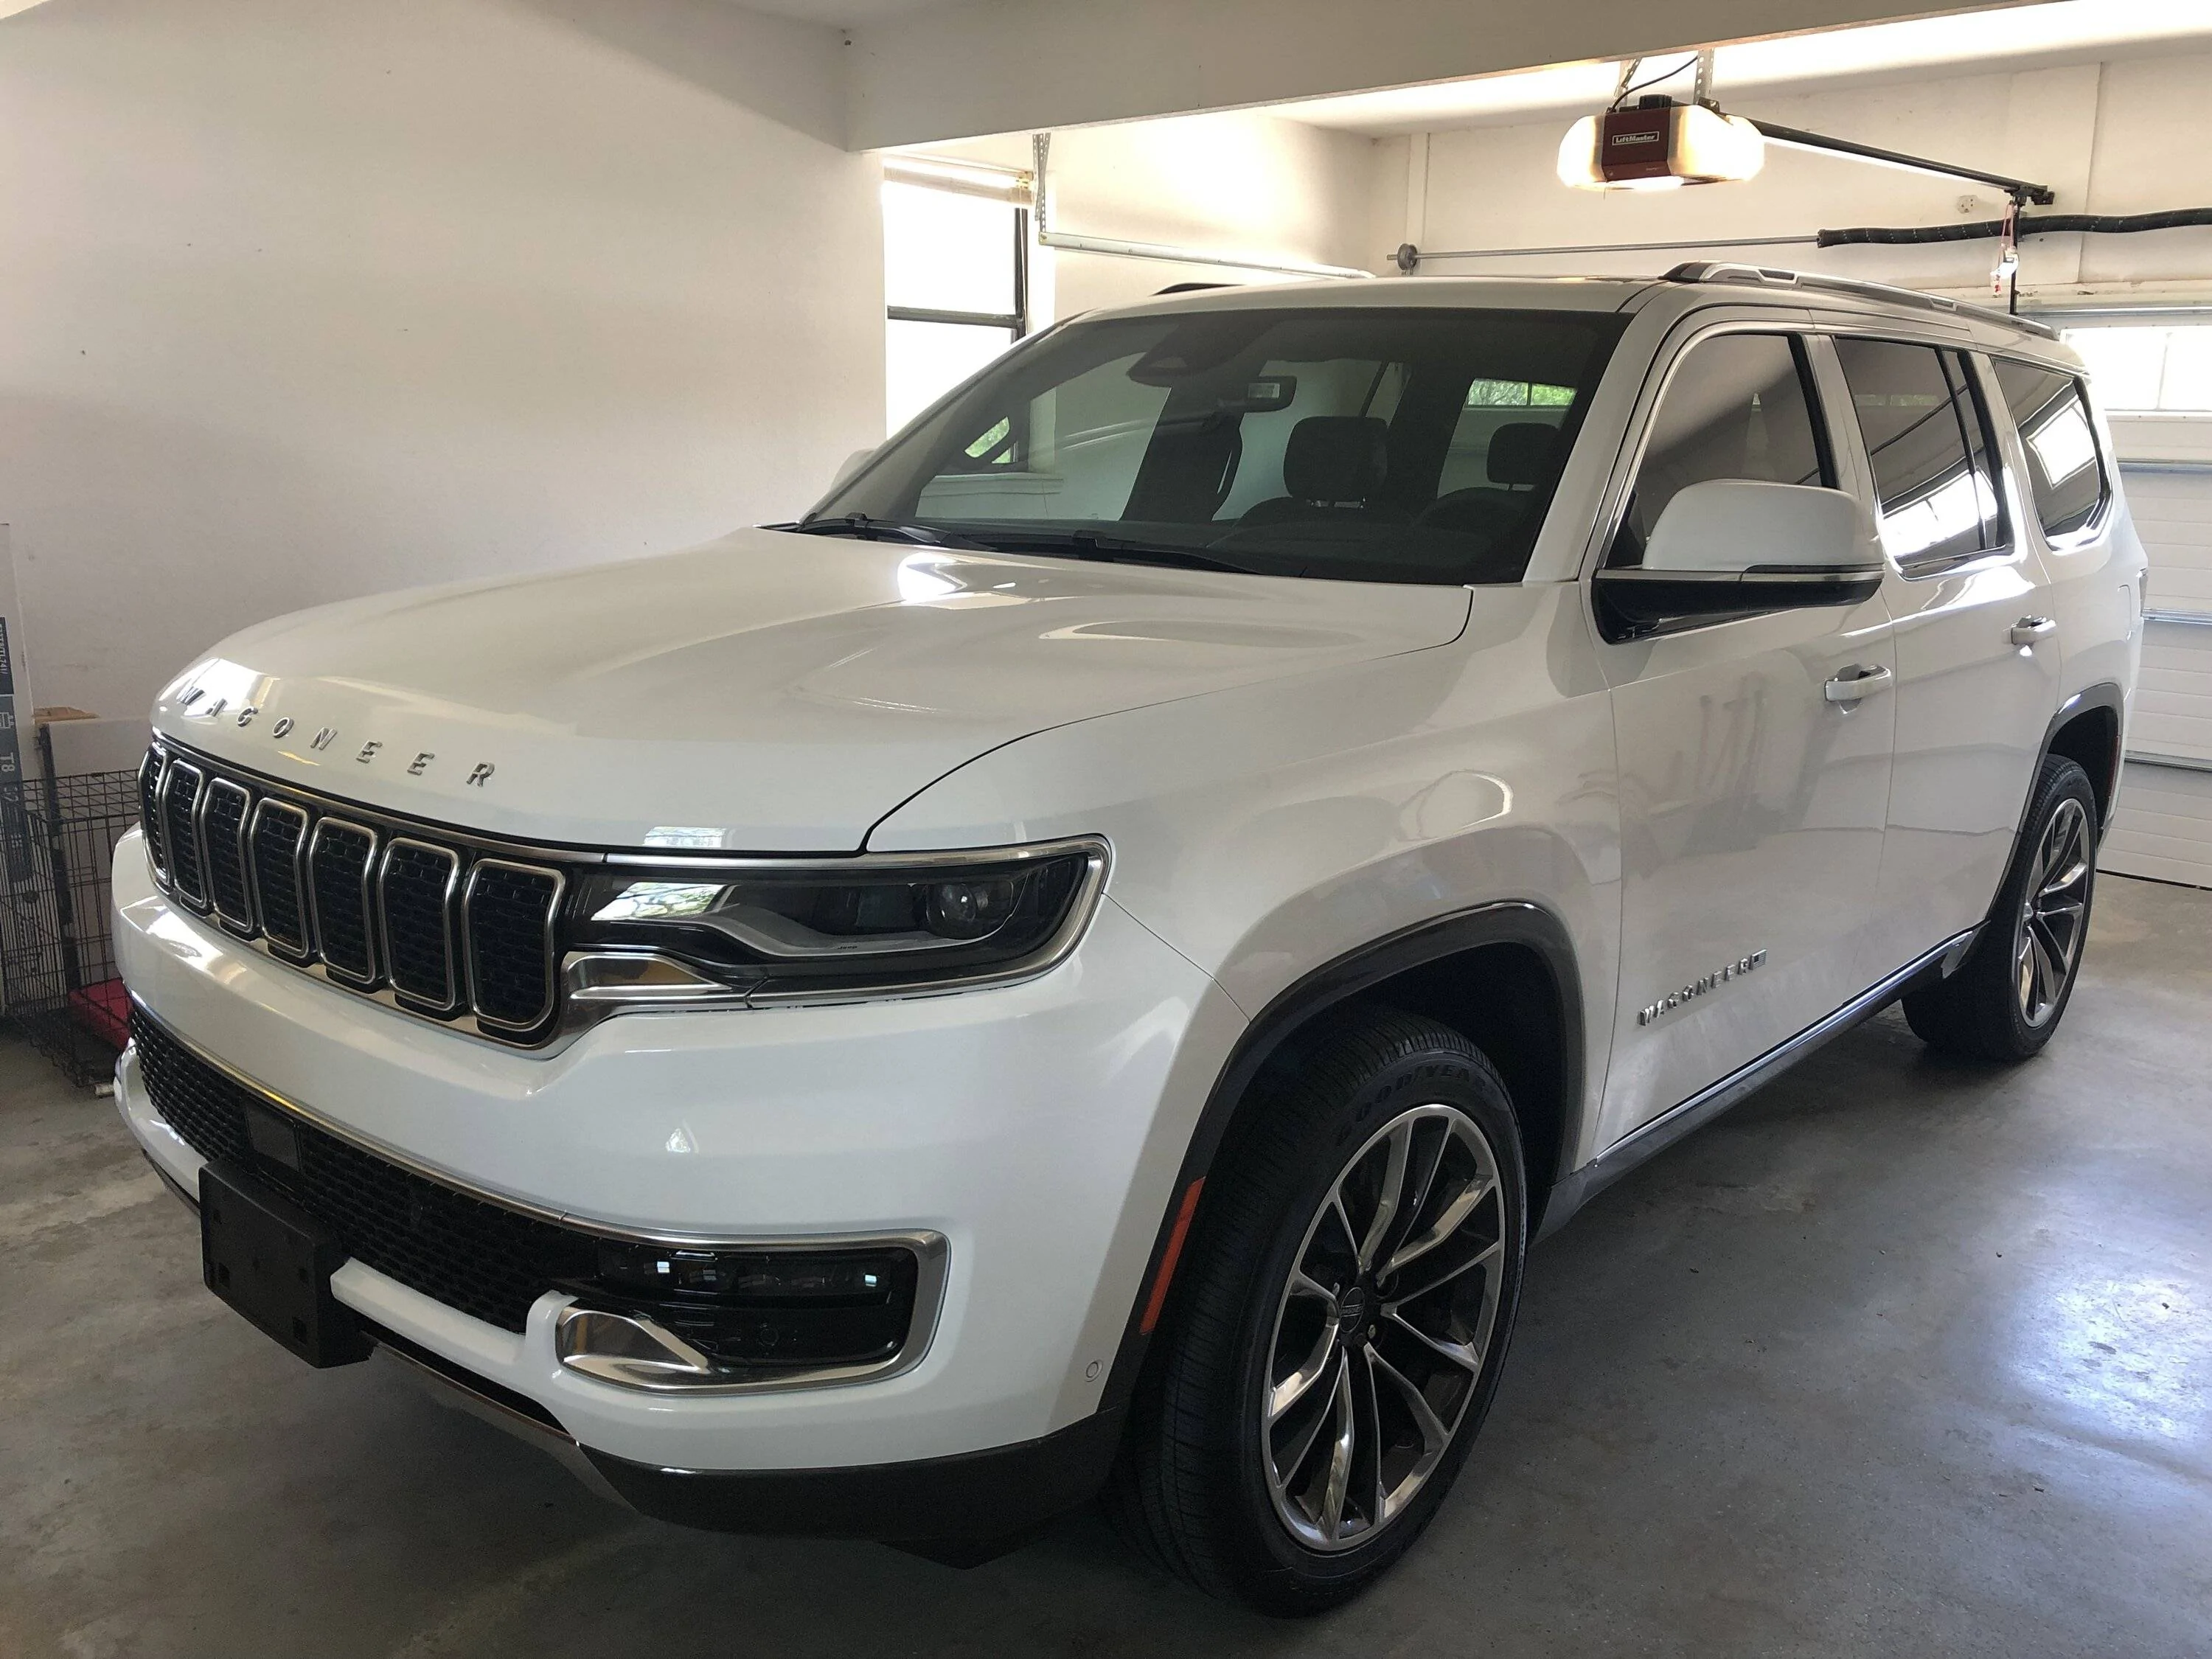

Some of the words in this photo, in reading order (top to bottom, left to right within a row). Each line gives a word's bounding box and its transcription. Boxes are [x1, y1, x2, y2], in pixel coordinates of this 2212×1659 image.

[1615, 134, 1655, 144] LiftMaster
[176, 686, 495, 787] WAGONEER
[1636, 958, 1748, 1026] WAGONEER
